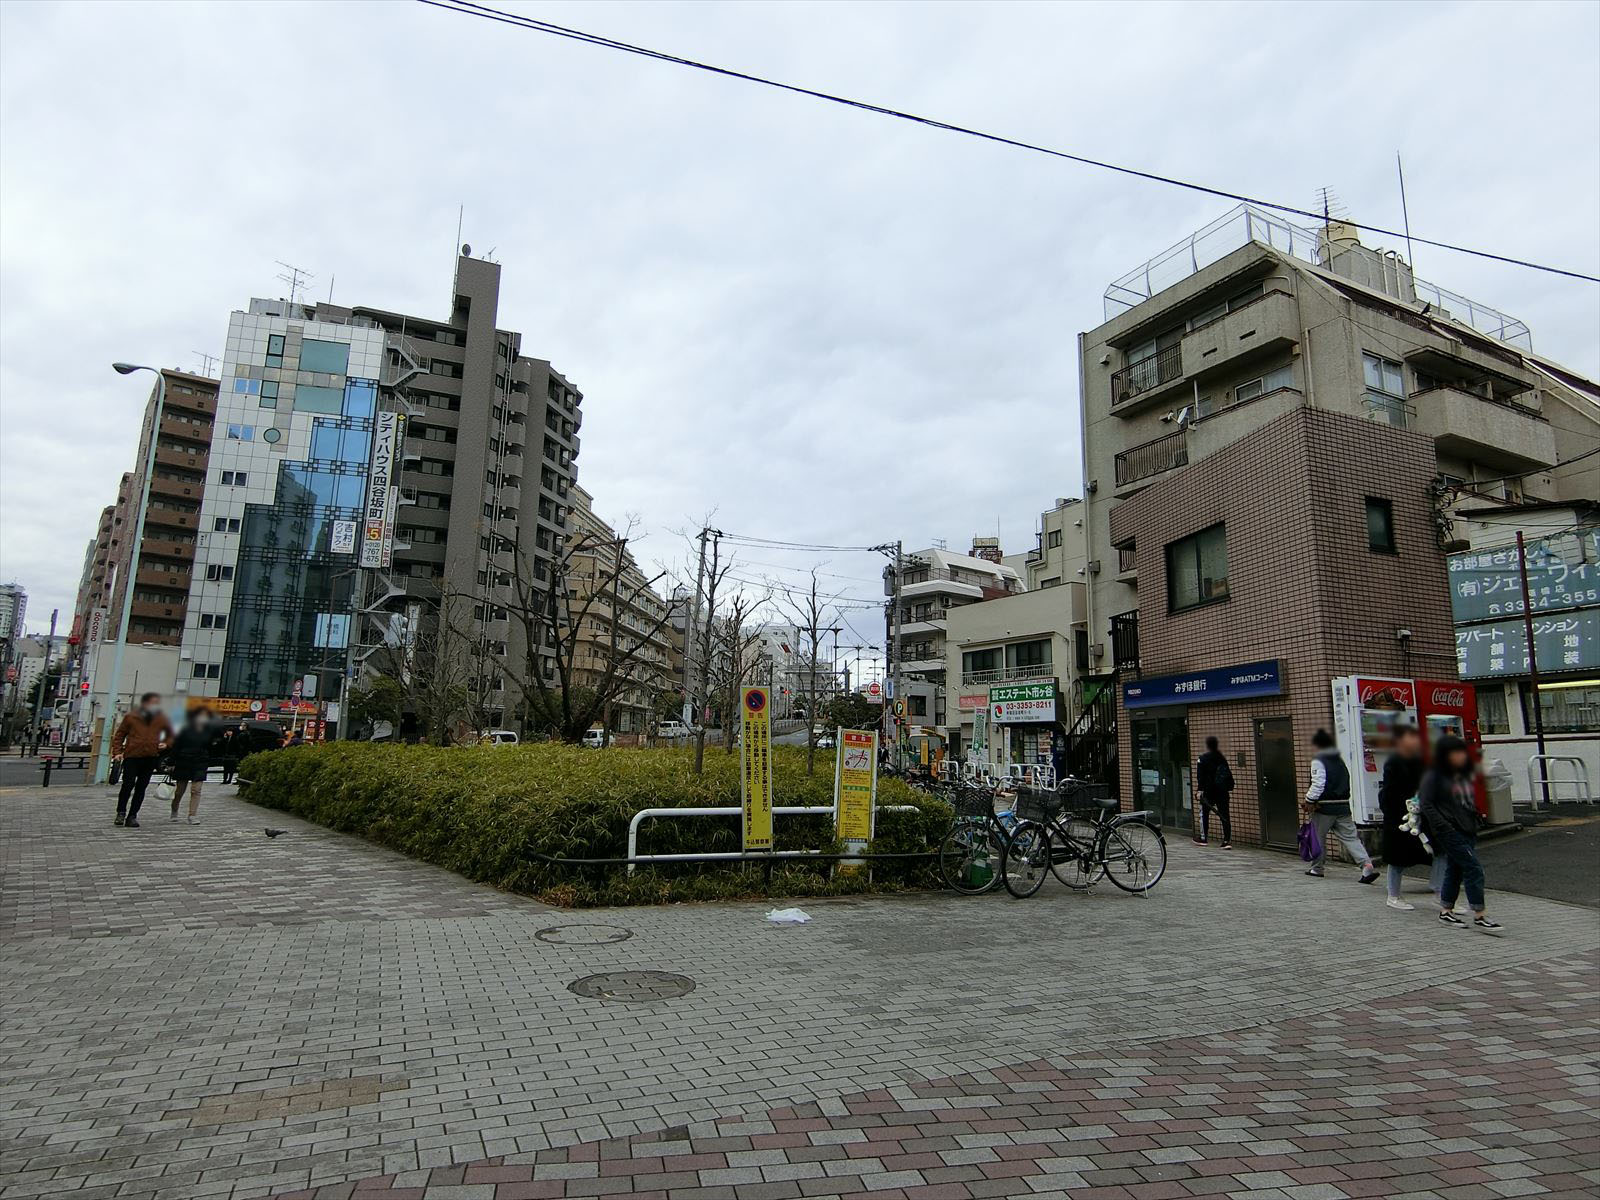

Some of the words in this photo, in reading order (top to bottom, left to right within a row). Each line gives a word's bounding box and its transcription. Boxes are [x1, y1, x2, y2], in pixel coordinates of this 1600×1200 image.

[368, 413, 394, 520] シティハウス四谷坂町
[343, 523, 355, 543] 吉村
[91, 611, 101, 642] docomo
[1174, 679, 1207, 693] みずほ銀行
[1230, 673, 1274, 685] みずほATMコーナー
